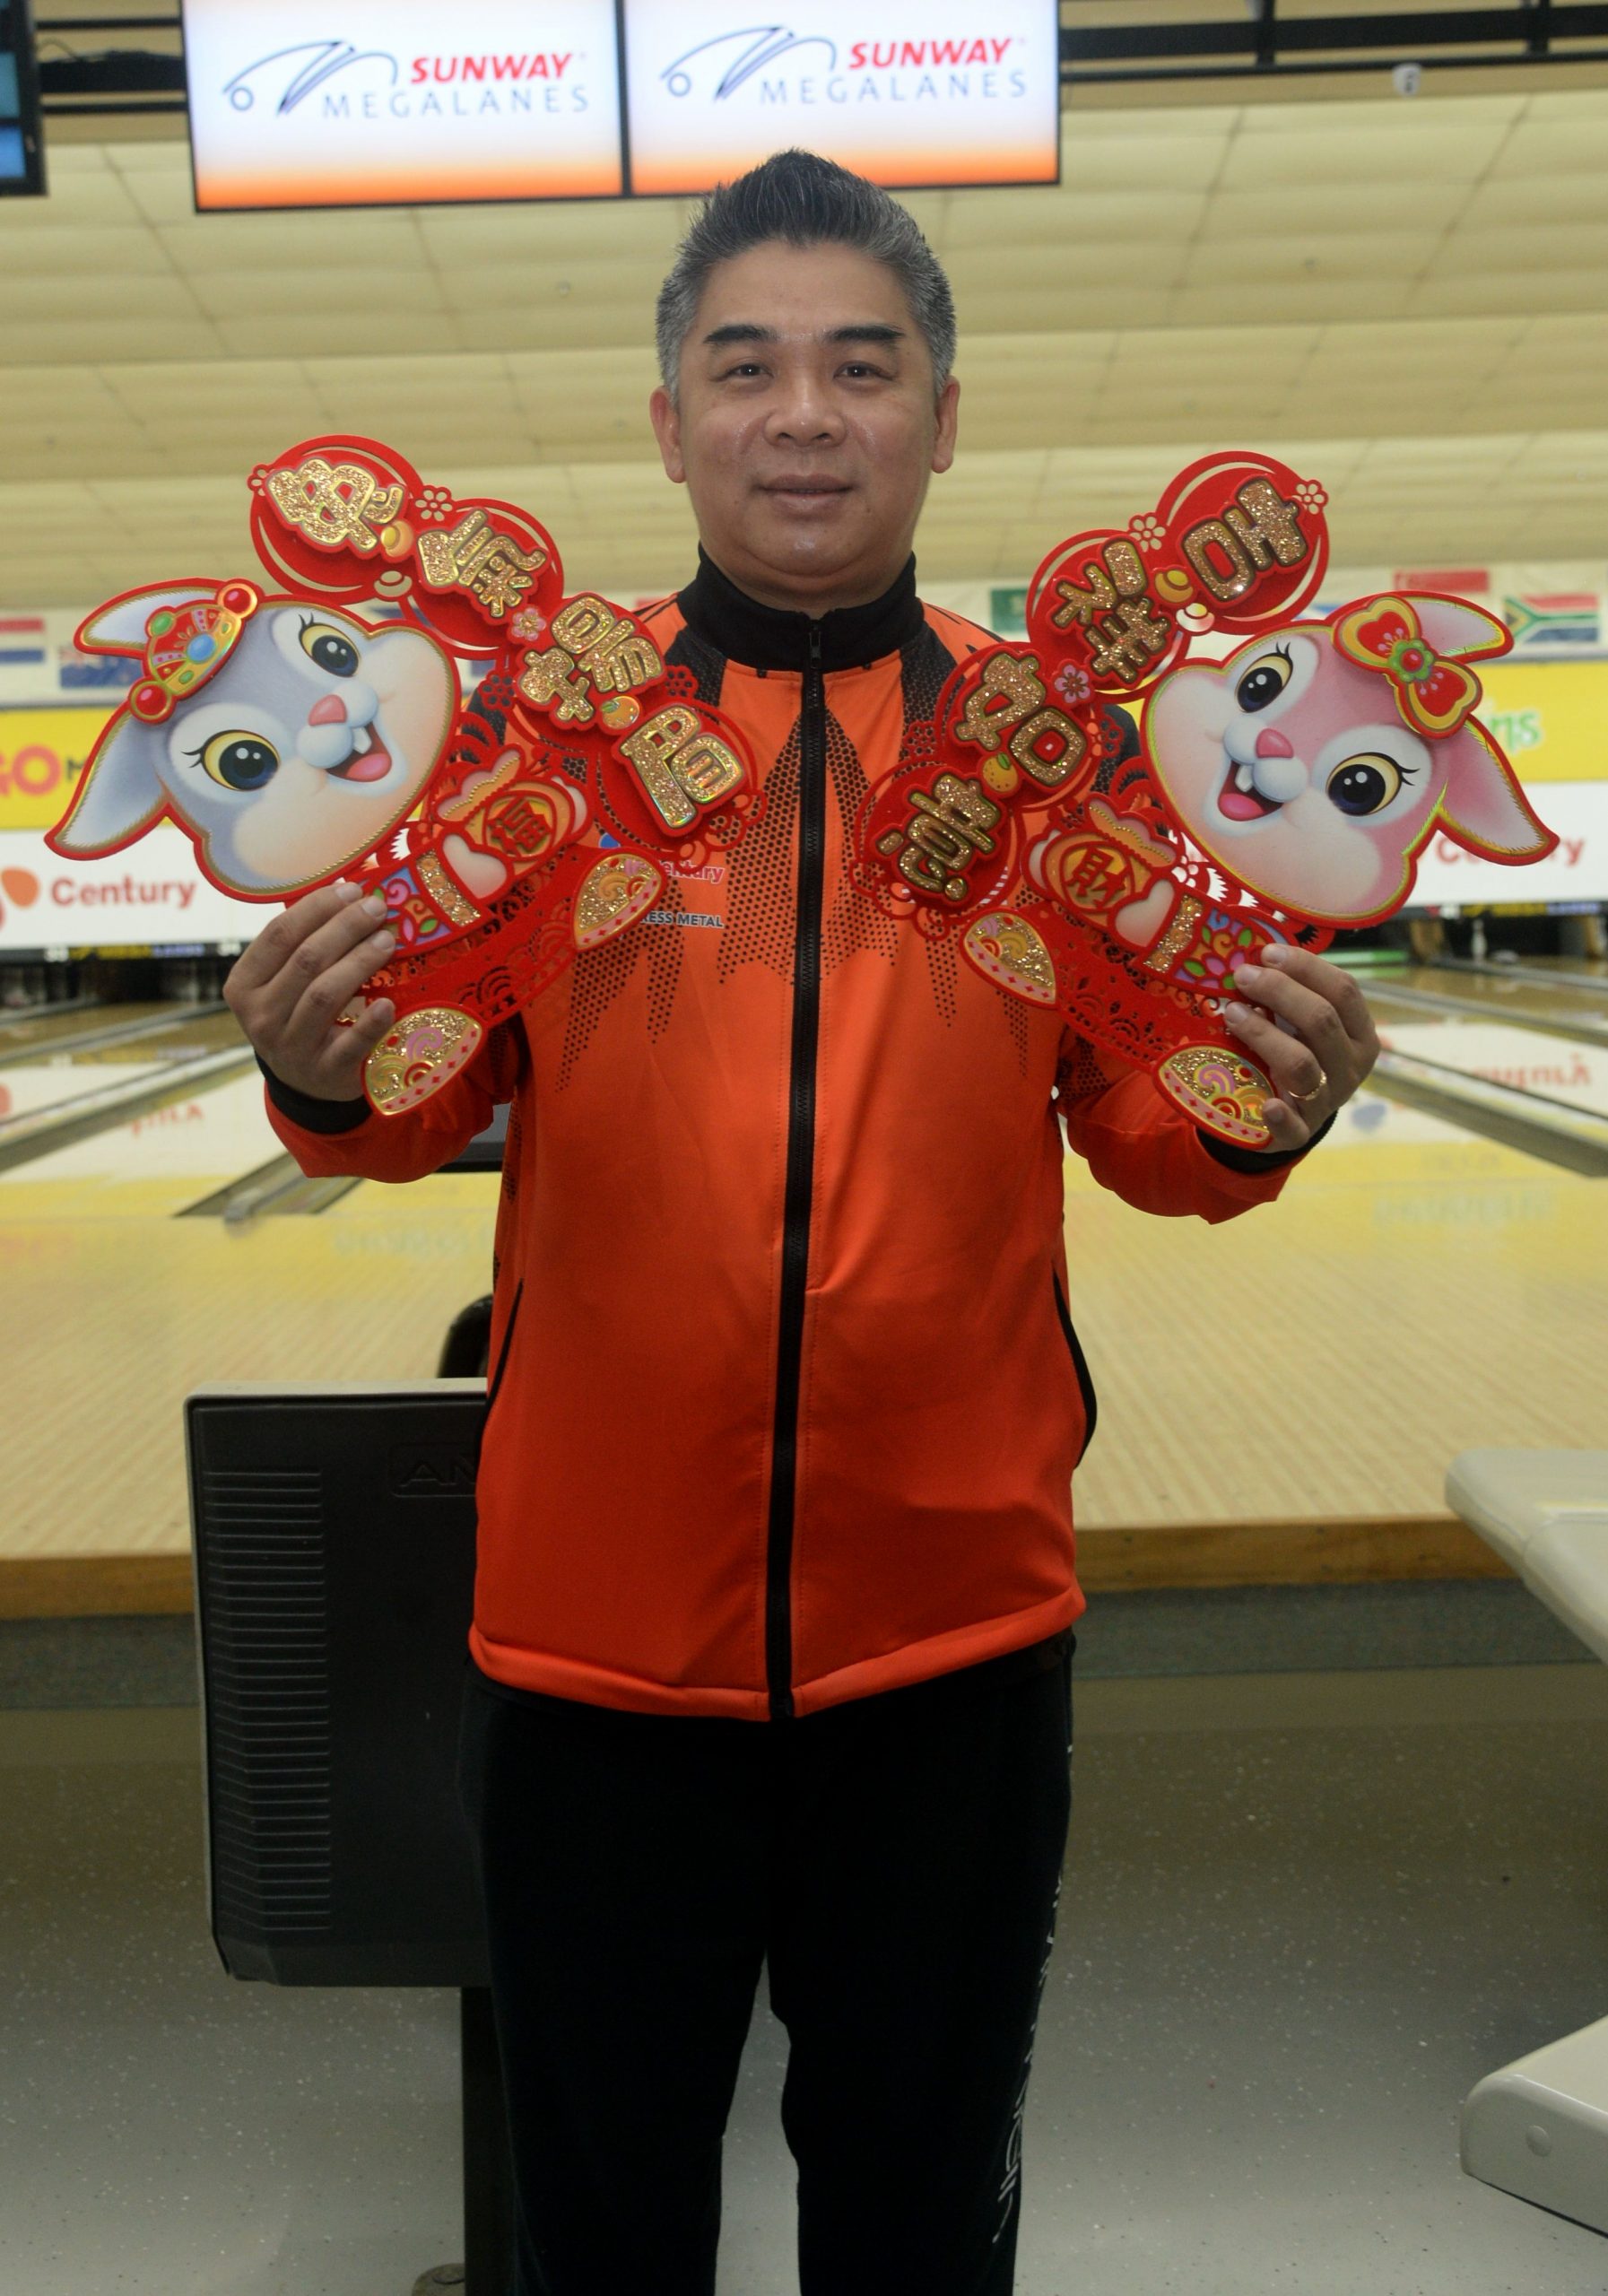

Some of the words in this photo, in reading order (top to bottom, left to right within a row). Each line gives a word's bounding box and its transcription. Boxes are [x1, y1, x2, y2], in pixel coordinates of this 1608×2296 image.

[411, 53, 572, 84] SUNWAY
[849, 38, 1012, 70] SUNWAY
[322, 85, 589, 118] MEGALANES
[759, 70, 1028, 105] MEGALANES
[875, 477, 1308, 900] 吉祥如意
[487, 794, 552, 856] 福
[51, 874, 196, 909] Century
[677, 912, 724, 927] METAL
